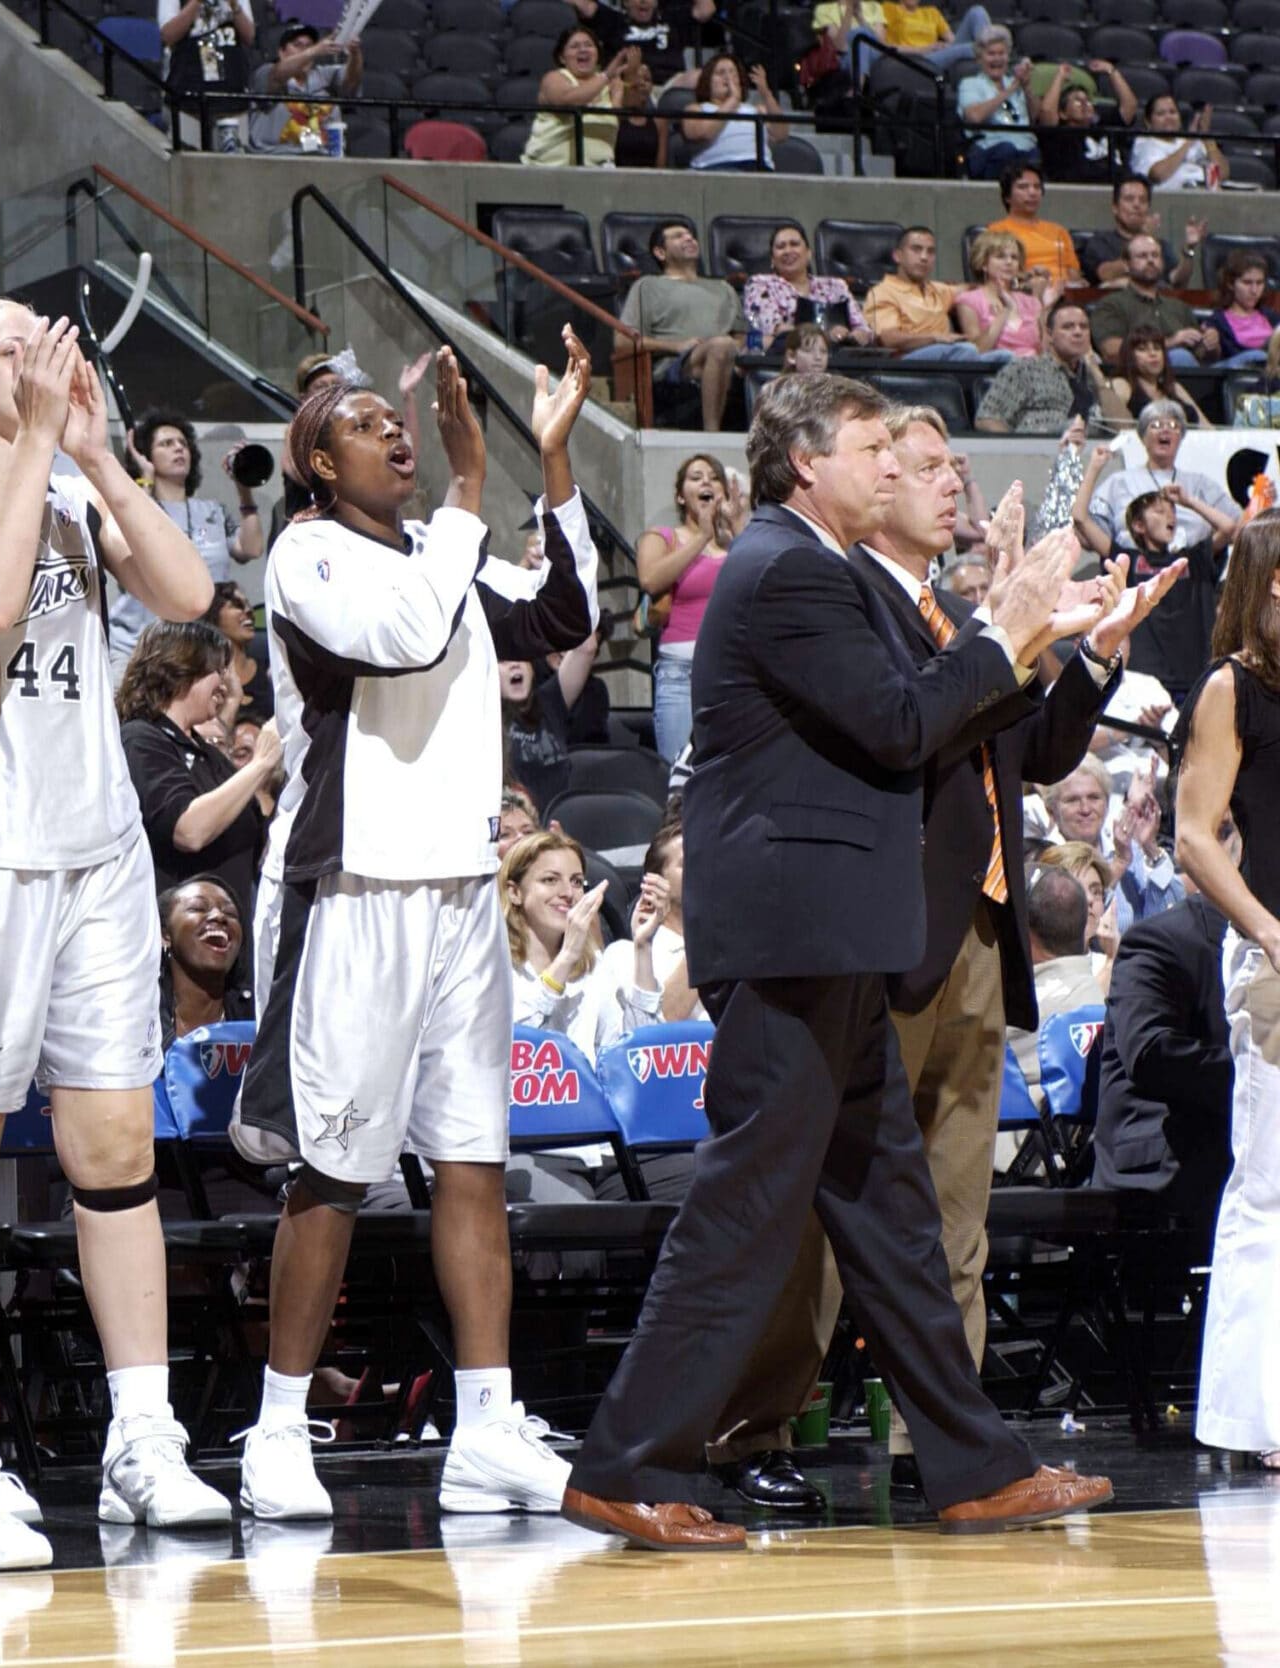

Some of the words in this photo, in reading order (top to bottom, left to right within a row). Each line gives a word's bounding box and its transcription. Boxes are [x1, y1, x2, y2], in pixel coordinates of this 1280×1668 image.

[6, 642, 81, 700] 44
[511, 1039, 562, 1072] BA
[651, 1041, 713, 1078] WN
[511, 1070, 580, 1106] OM
